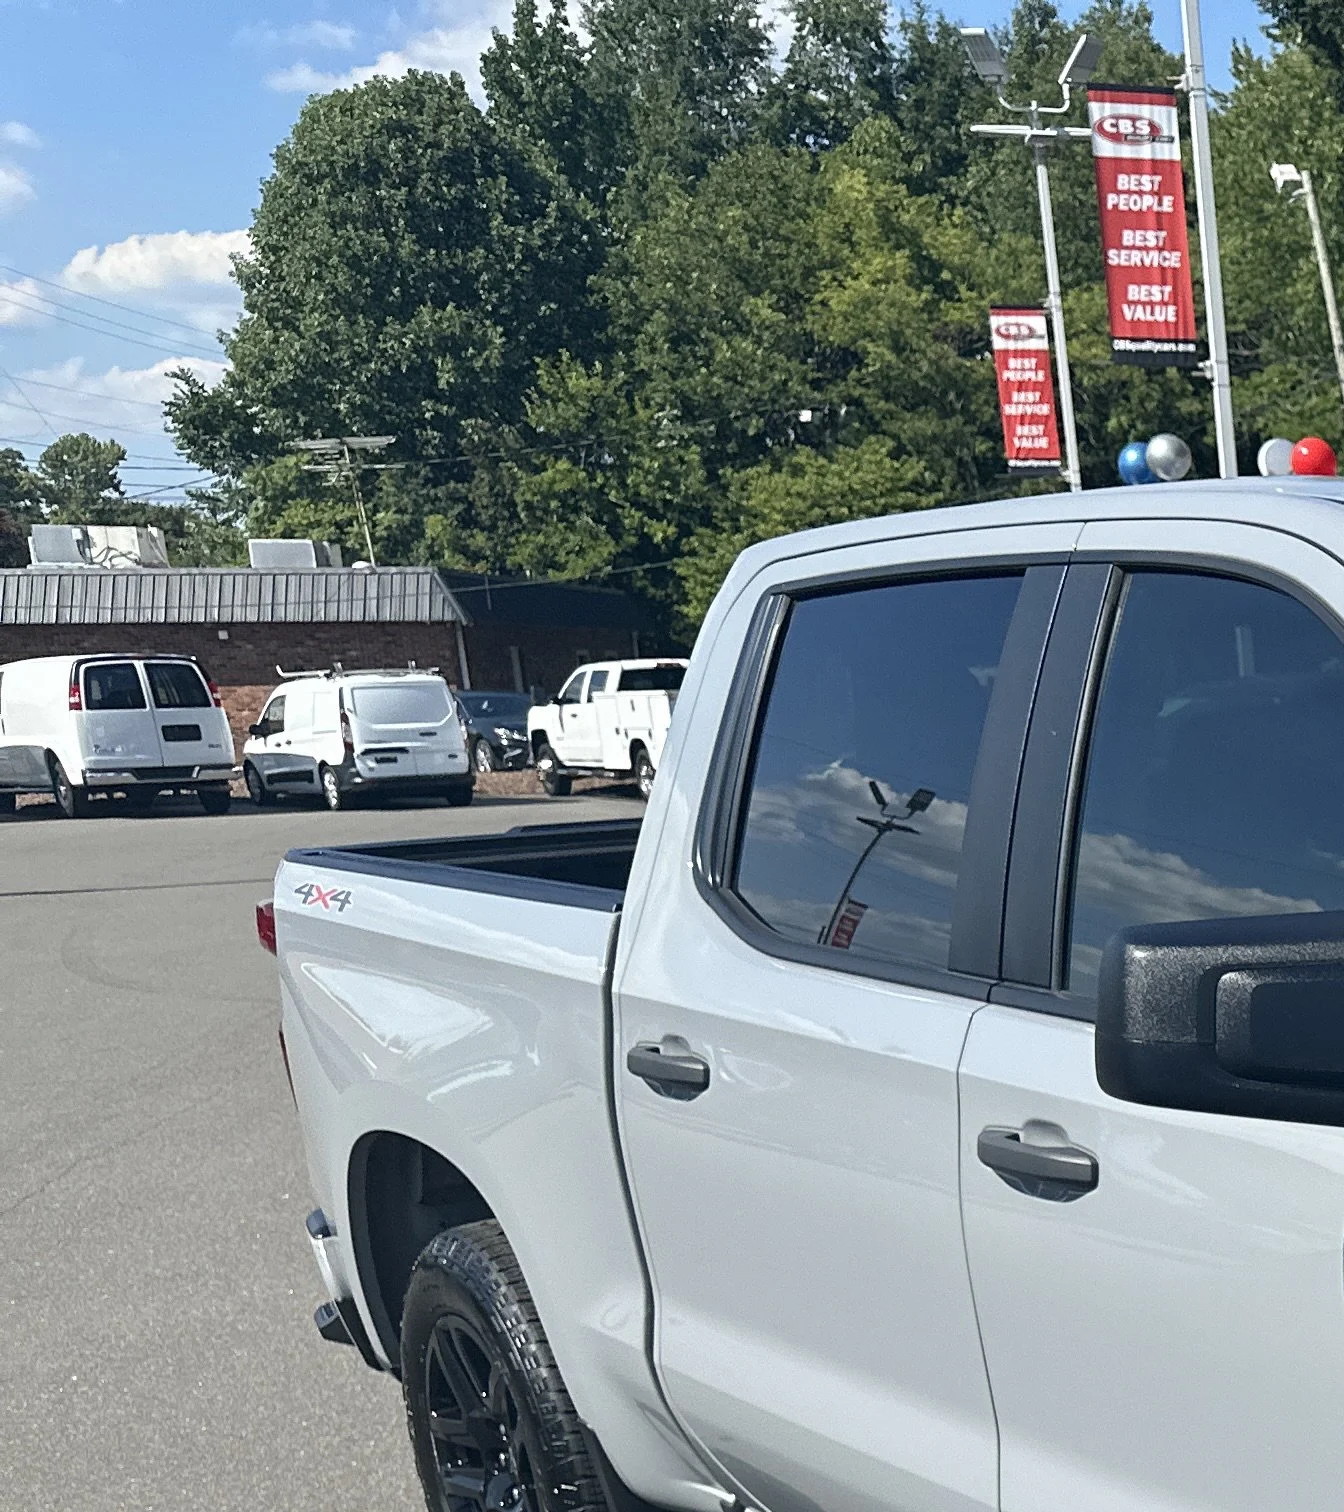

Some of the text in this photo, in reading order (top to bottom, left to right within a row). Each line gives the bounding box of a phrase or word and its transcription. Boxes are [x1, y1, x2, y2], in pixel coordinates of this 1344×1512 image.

[1102, 118, 1151, 135] CBS
[1116, 173, 1162, 192] BEST
[1106, 193, 1175, 213] PEOPLE
[1121, 229, 1168, 248] BEST
[1107, 249, 1182, 268] SERVICE
[1127, 284, 1173, 302] BEST
[1121, 303, 1178, 322] VALUE
[1008, 357, 1038, 370] BEST
[1002, 369, 1046, 382] PEOPLE
[1011, 391, 1042, 403] BEST
[1003, 403, 1051, 416] SERVICE
[1015, 424, 1046, 436] BEST
[1012, 436, 1050, 449] VALUE
